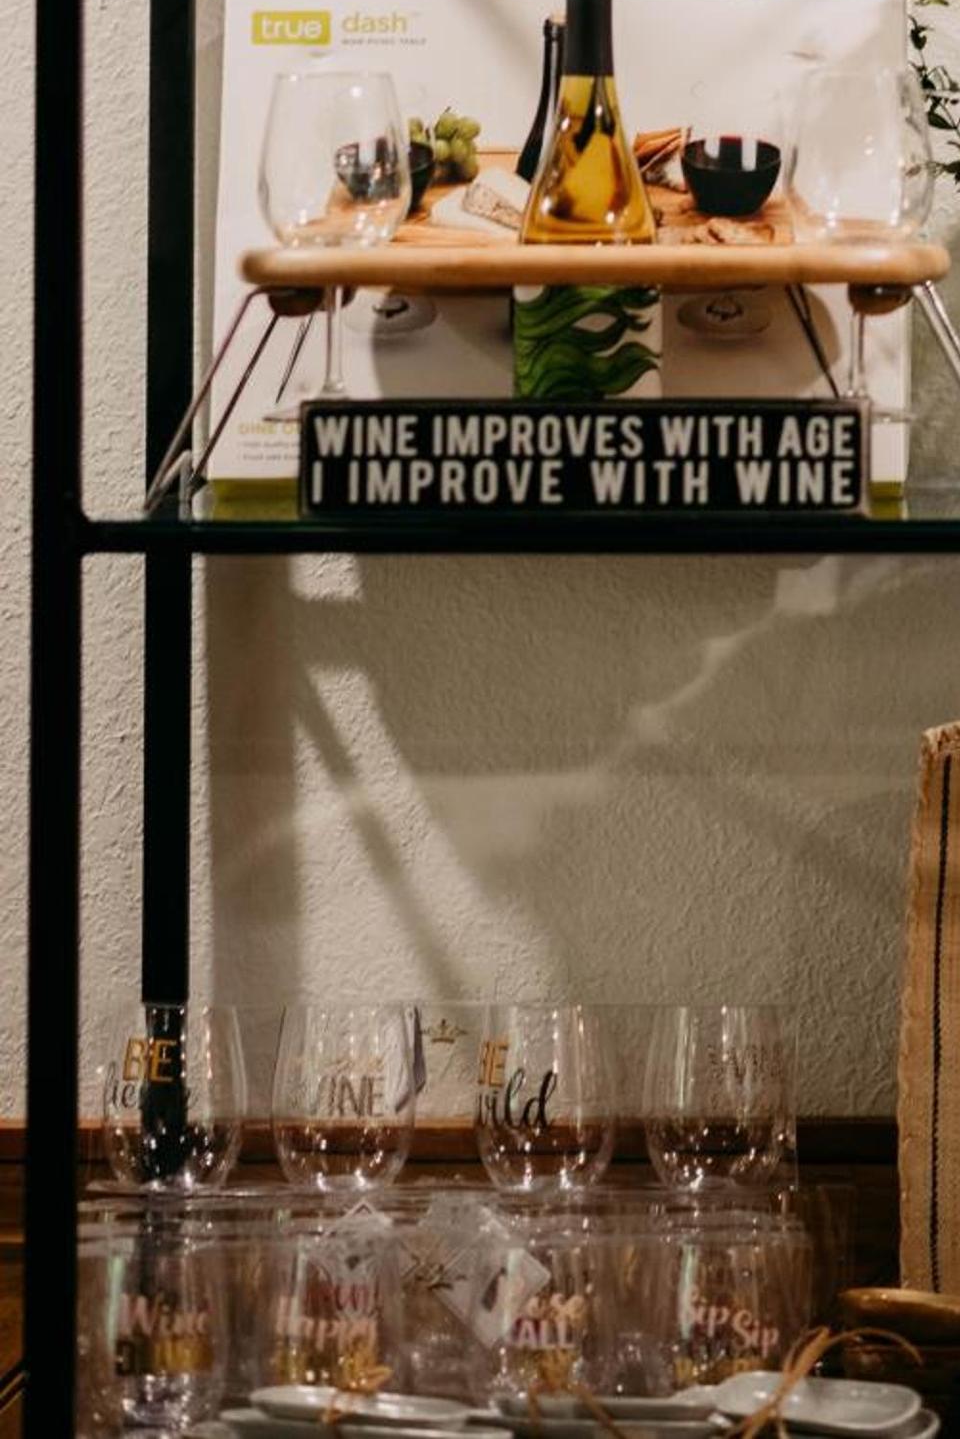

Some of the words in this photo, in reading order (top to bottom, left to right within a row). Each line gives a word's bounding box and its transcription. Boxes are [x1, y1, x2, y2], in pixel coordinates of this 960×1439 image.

[260, 15, 325, 40] true
[341, 10, 408, 34] dash
[315, 416, 417, 456] WINE
[433, 415, 643, 457] IMPROVES
[661, 416, 762, 457] WITH
[778, 416, 854, 457] AGE
[312, 461, 323, 503] I
[349, 461, 562, 503] IMPROVE
[591, 461, 708, 504] WITH
[735, 461, 853, 504] WINE
[122, 1037, 177, 1082] BE
[732, 1309, 780, 1357] Sip
